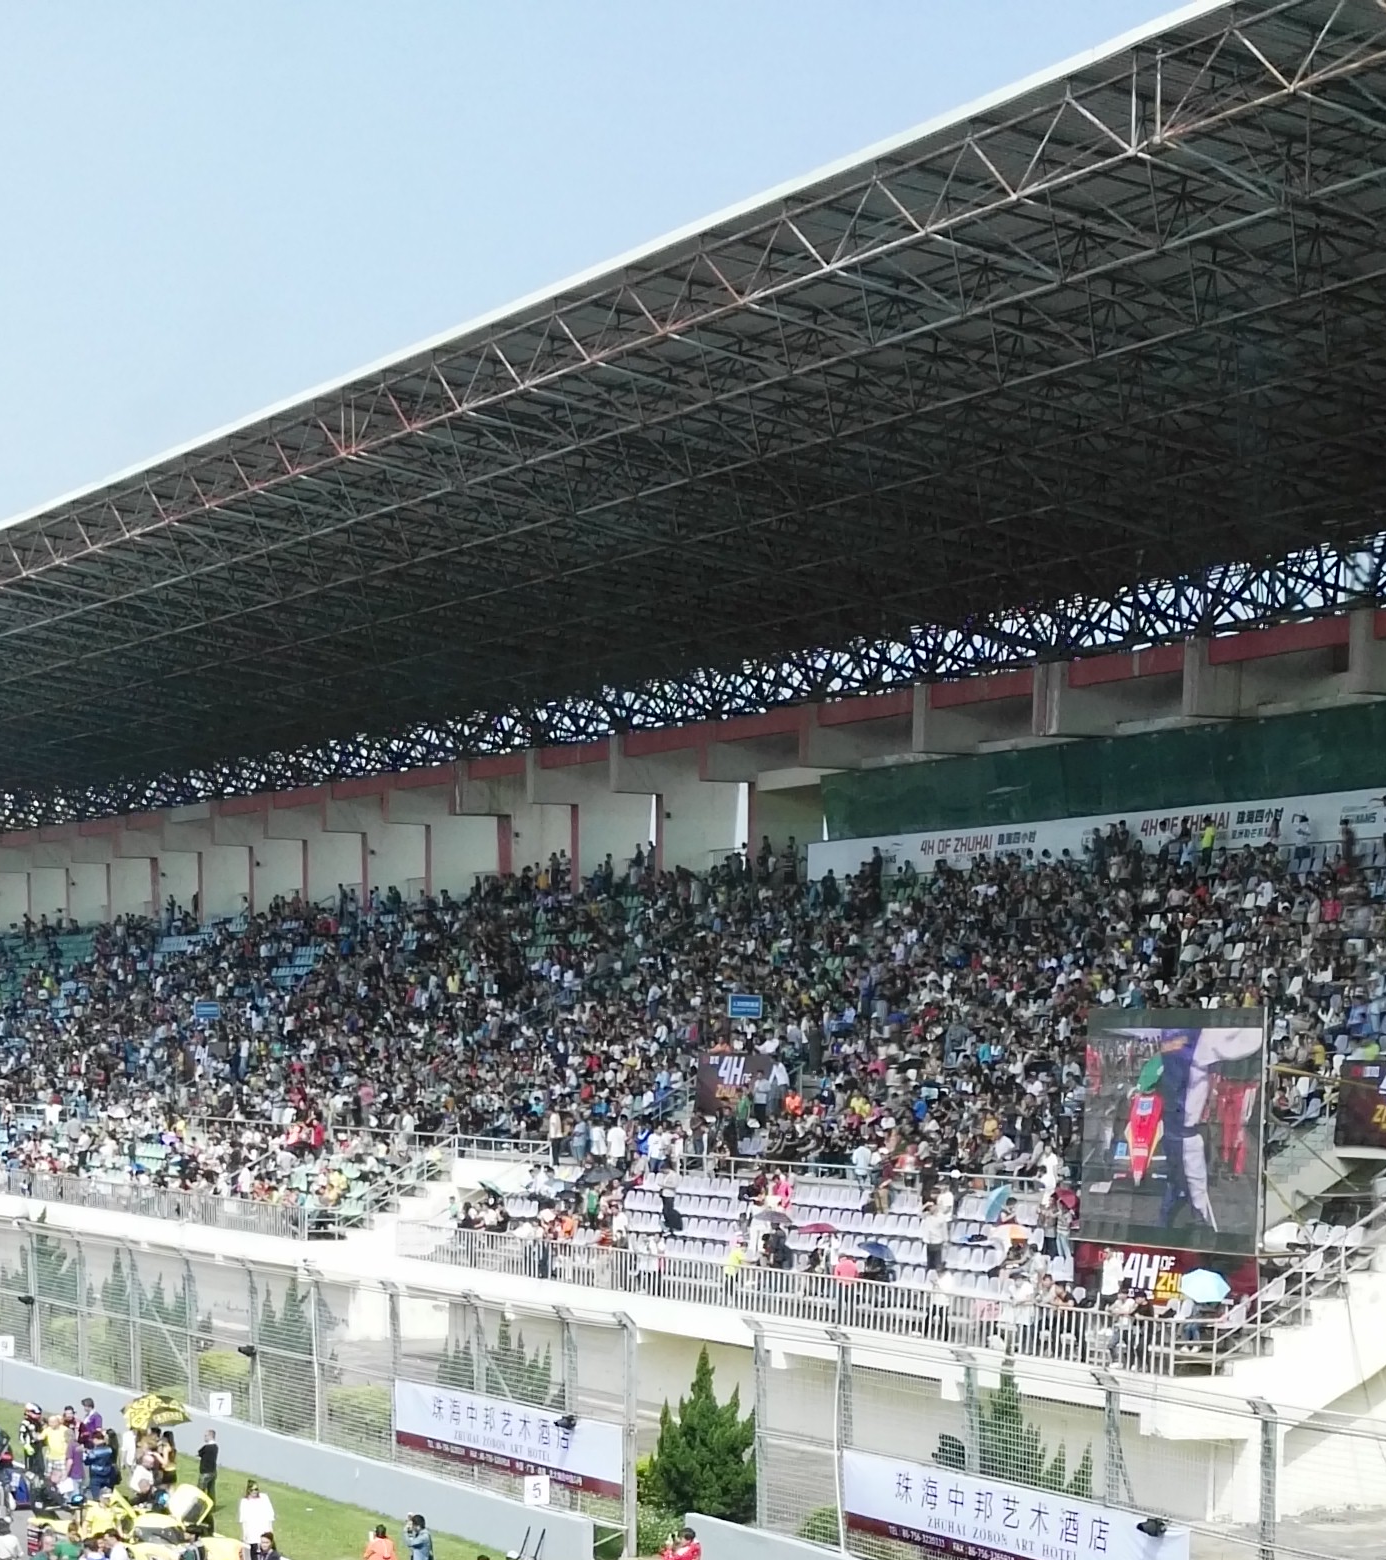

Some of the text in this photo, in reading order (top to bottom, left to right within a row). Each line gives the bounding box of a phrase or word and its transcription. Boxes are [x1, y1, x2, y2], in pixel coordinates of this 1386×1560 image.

[1140, 818, 1158, 837] 4H
[920, 839, 934, 855] 4H
[937, 838, 951, 854] OF
[953, 834, 993, 853] ZHUHAI
[718, 1056, 745, 1085] 4H
[1123, 1252, 1160, 1290] 4H
[1160, 1255, 1176, 1271] OF
[895, 1471, 1109, 1554] 珠海中邦艺术酒店
[928, 1516, 966, 1536] ZHUHAI
[973, 1527, 1008, 1546] ZOBON
[1015, 1538, 1034, 1554] ART
